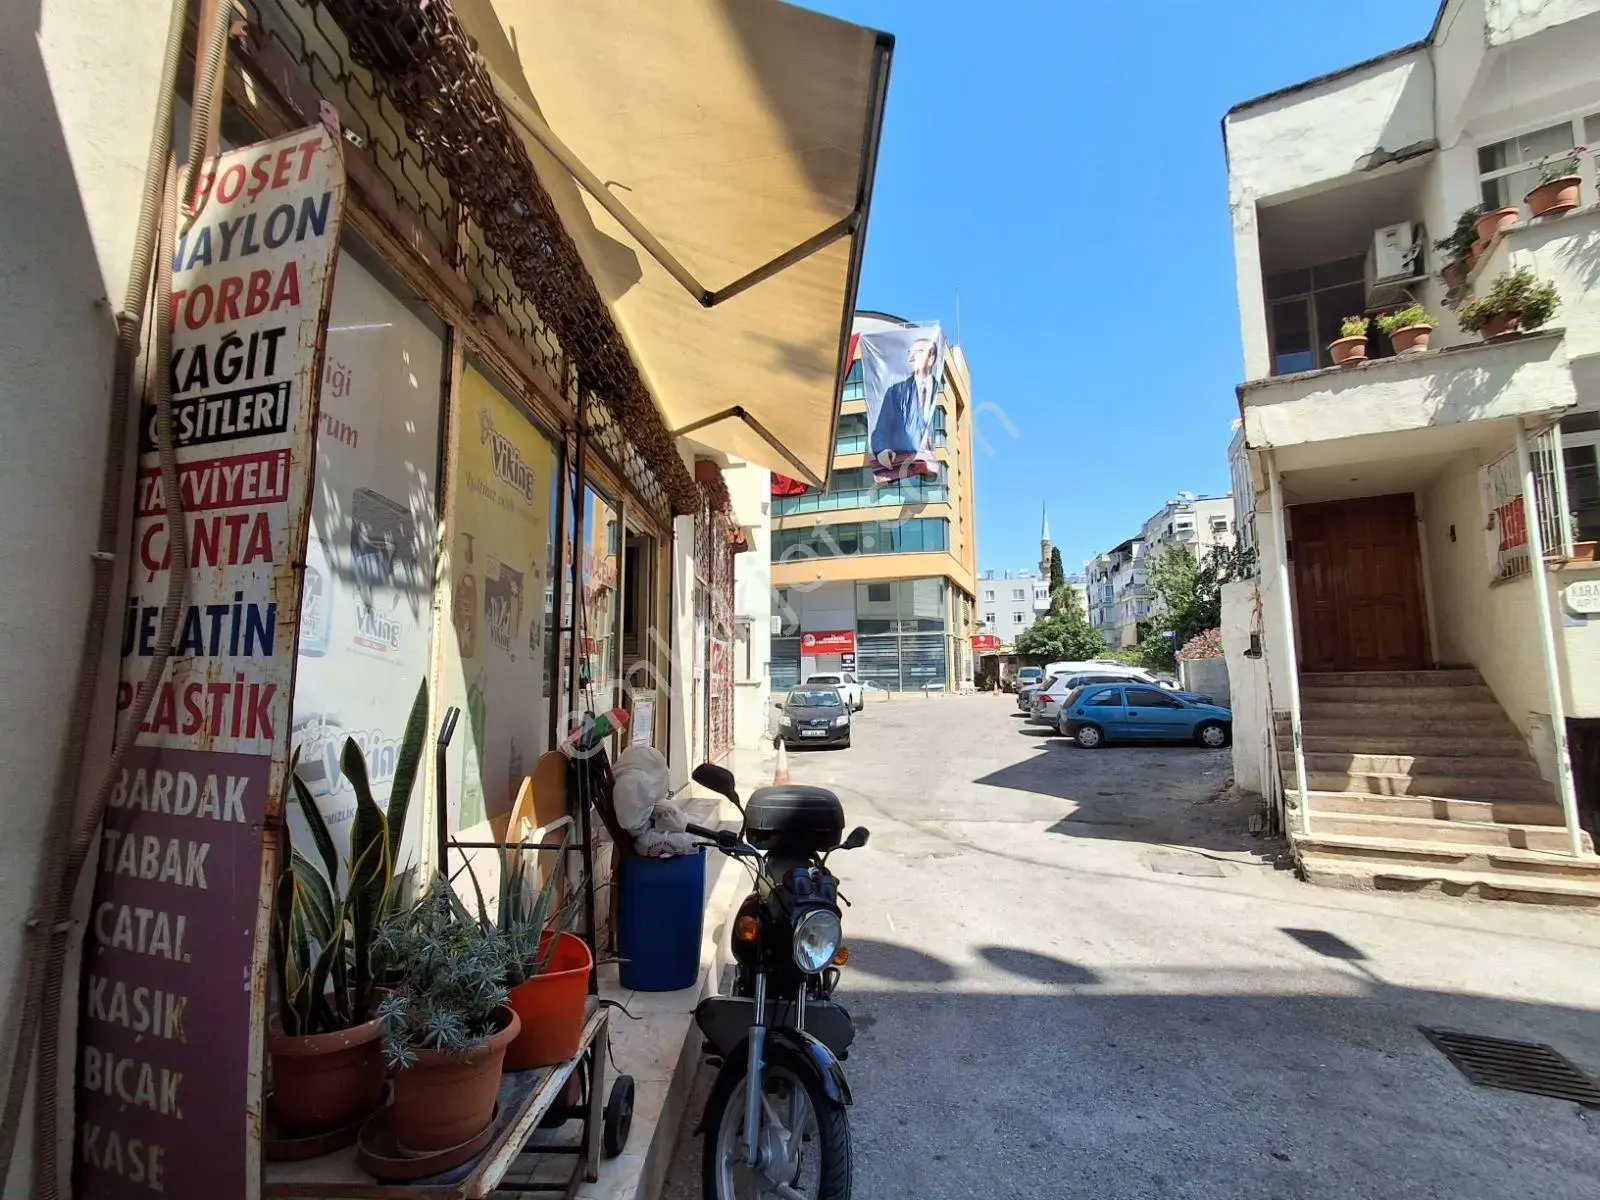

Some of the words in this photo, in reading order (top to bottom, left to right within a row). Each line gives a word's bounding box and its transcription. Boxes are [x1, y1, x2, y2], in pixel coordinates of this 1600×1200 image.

[190, 137, 323, 214] POŞET
[169, 261, 301, 333] TORBA
[491, 432, 536, 506] Viking
[354, 602, 401, 649] Viking
[109, 767, 250, 824] BARDAK
[104, 828, 211, 890] TABAK
[93, 901, 191, 963] ÇATAL
[87, 972, 188, 1044] KAŞIK
[83, 1044, 184, 1120] BIÇAK
